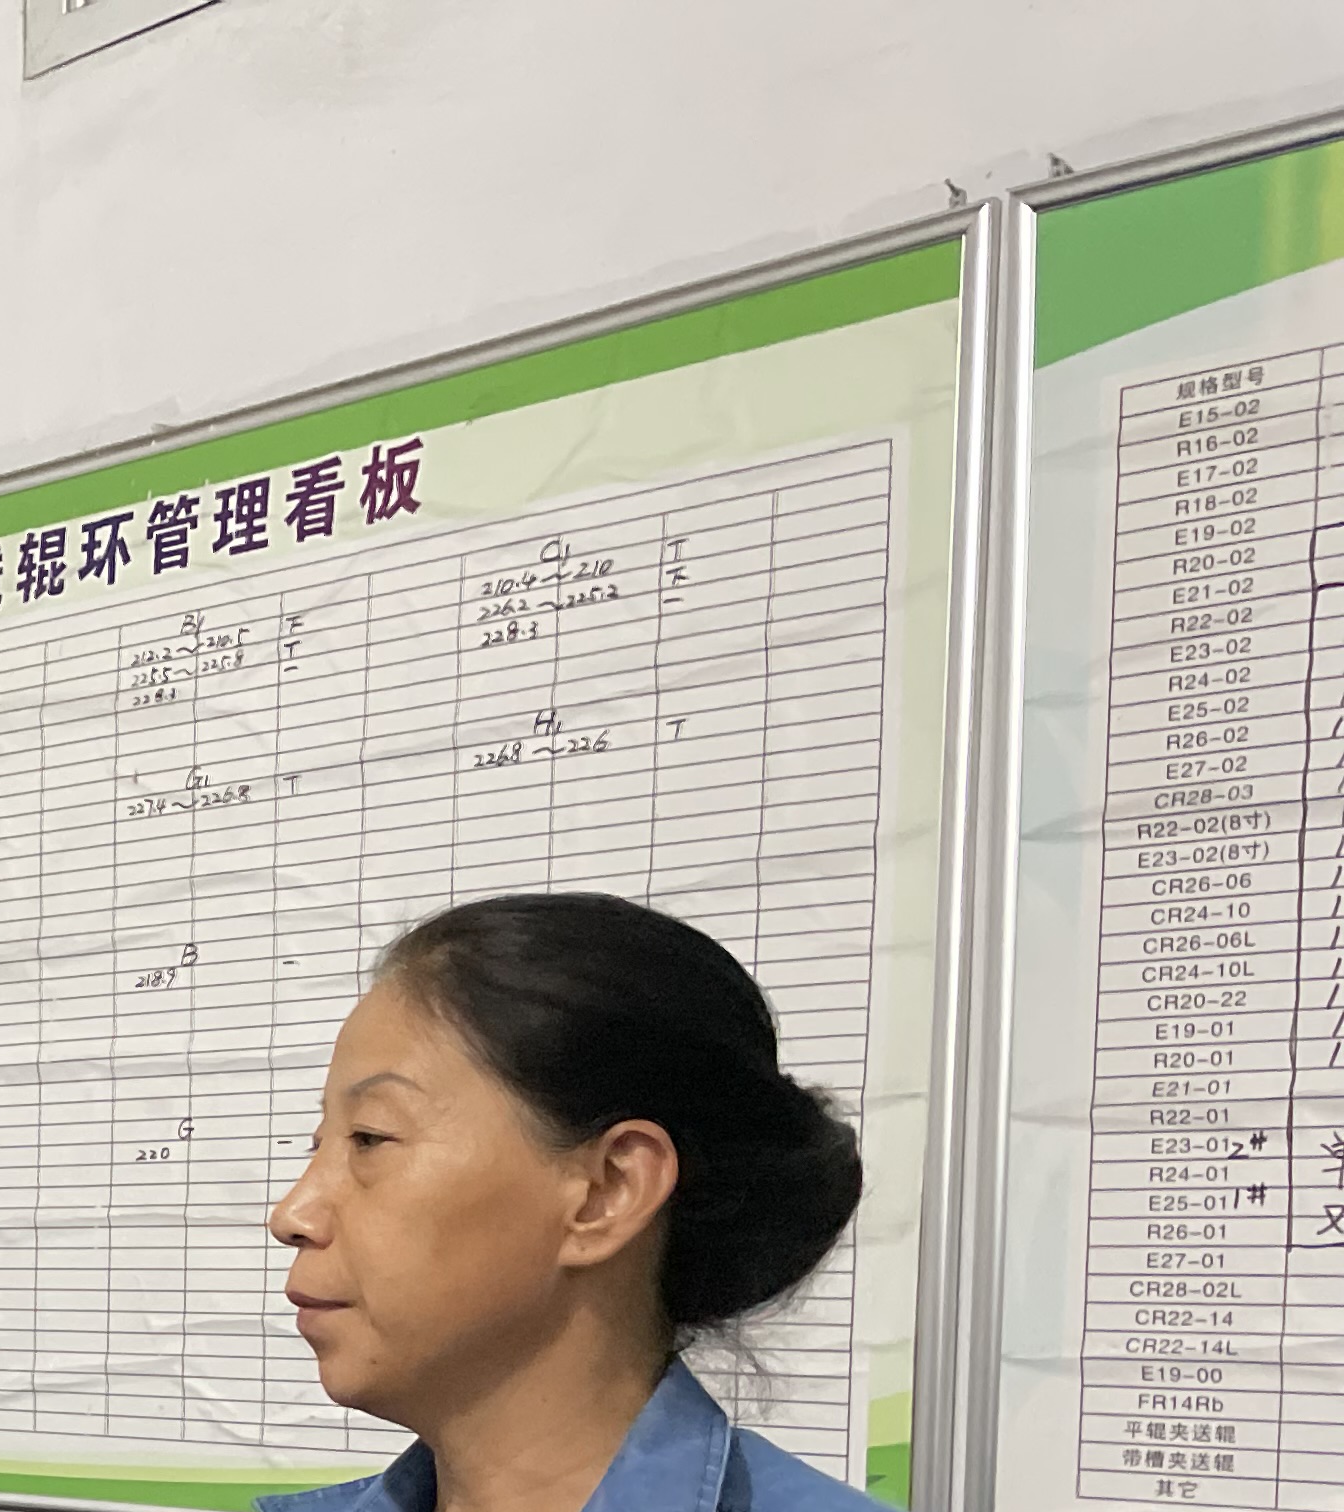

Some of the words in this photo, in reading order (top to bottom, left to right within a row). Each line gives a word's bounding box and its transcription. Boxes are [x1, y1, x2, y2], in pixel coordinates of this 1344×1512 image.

[1176, 366, 1266, 400] 规格型号
[1178, 398, 1261, 429] E15-02
[1177, 427, 1259, 457] R16-02
[1177, 457, 1259, 487] E17-02
[1175, 487, 1258, 517] R18-02
[1174, 518, 1256, 546] E19-02
[1172, 547, 1255, 575] R20-02
[1172, 577, 1254, 605] E21-02
[1170, 606, 1253, 634] R22-02
[1169, 636, 1252, 664] E23-02
[1168, 665, 1251, 693] R24-02
[1167, 695, 1250, 723] E25-02
[1166, 725, 1249, 751] R26-02
[1165, 754, 1248, 781] E27-02
[1154, 784, 1254, 810] CR28-03
[1137, 811, 1271, 840] R22-02(8寸)
[1137, 840, 1270, 869] E23-02(8寸)
[1152, 873, 1252, 895] CR26-06
[1150, 902, 1251, 925] CR24-10
[1143, 931, 1256, 955] CR26-06L
[1141, 961, 1255, 984] CR24-10L
[1147, 991, 1247, 1011] CR20-22
[1155, 1020, 1234, 1040] E19-01
[1154, 1050, 1234, 1069] R20-01
[1152, 1080, 1231, 1098] E21-01
[1150, 1108, 1230, 1126] R22-01
[134, 1146, 171, 1162] 220
[1150, 1136, 1229, 1155] E23-01
[1149, 1166, 1229, 1183] R24-01
[1148, 1194, 1226, 1212] E25-01
[1147, 1223, 1227, 1241] R26-01
[1146, 1252, 1225, 1269] E27-01
[1129, 1280, 1242, 1299] CR28-02L
[1134, 1309, 1233, 1327] CR22-14
[1125, 1337, 1239, 1357] CR22-14L
[1141, 1366, 1223, 1384] E19-00
[1138, 1393, 1224, 1412] FR14Rb
[1154, 1478, 1199, 1499] 其它
